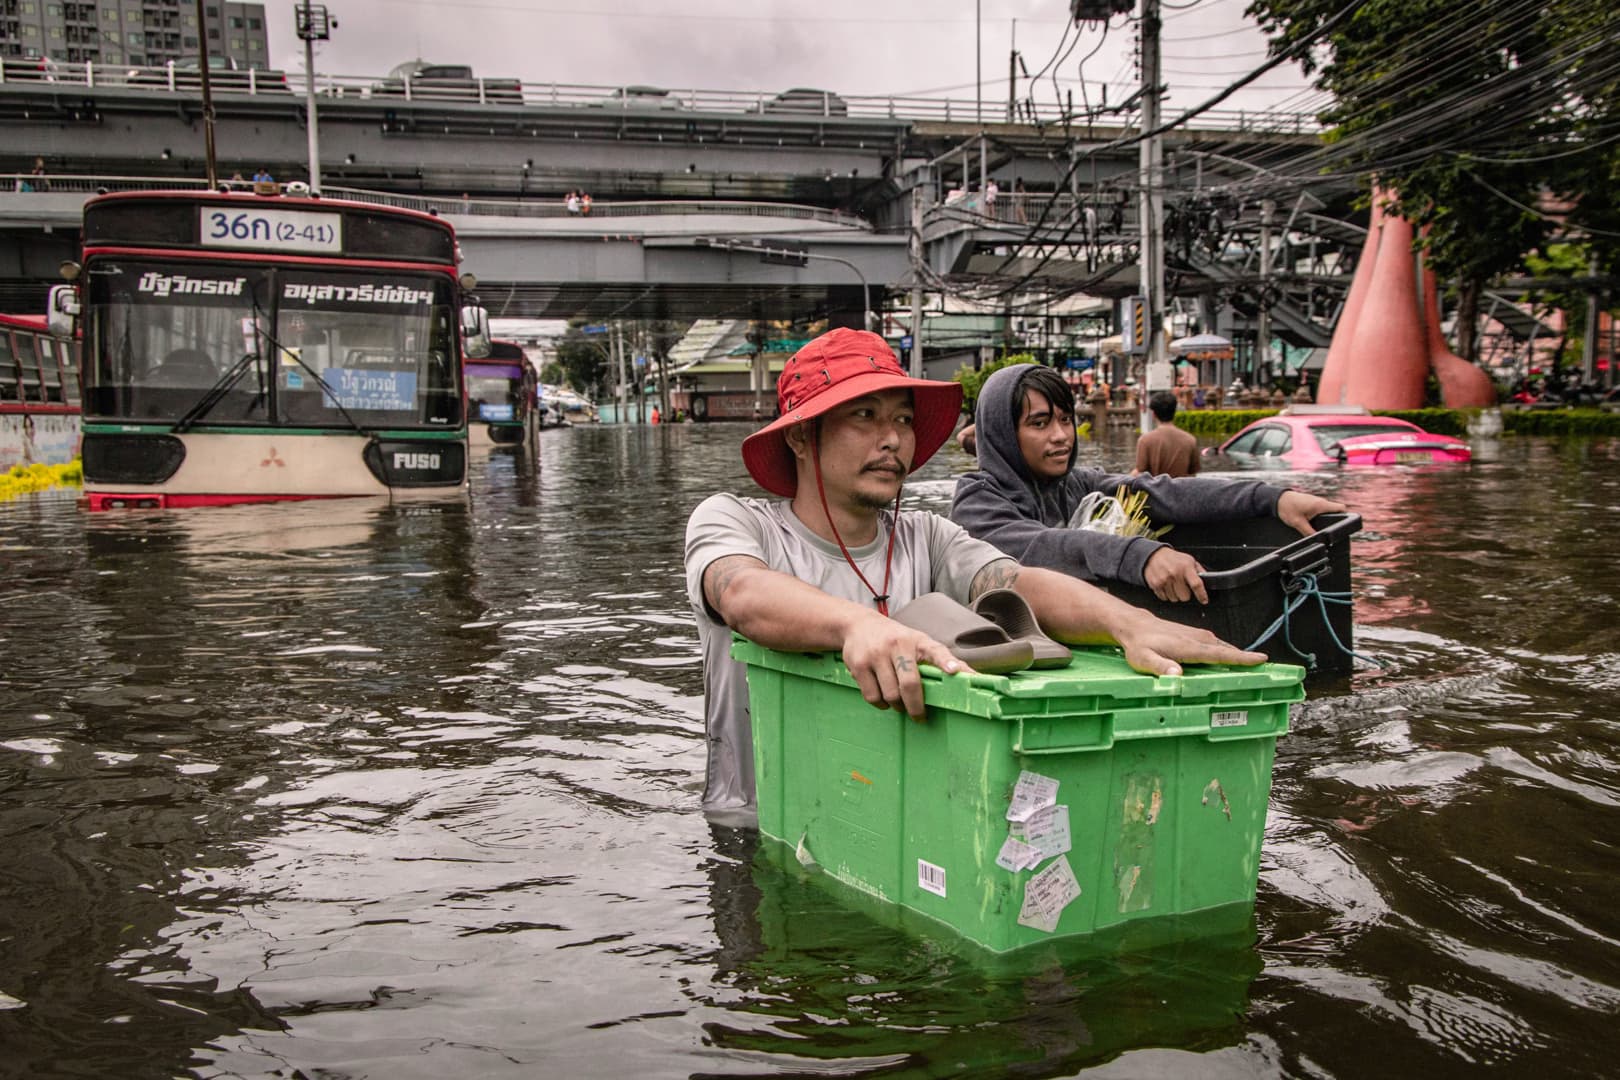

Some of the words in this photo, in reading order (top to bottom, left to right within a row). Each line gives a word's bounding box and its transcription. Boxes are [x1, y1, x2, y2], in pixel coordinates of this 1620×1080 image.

[210, 212, 270, 241] 36ก
[276, 221, 334, 244] (2-41)
[138, 272, 247, 297] ปัฐวิกรณ์
[283, 283, 435, 305] อนุสาวรีย์ชัยฯ
[393, 453, 441, 470] FUSO
